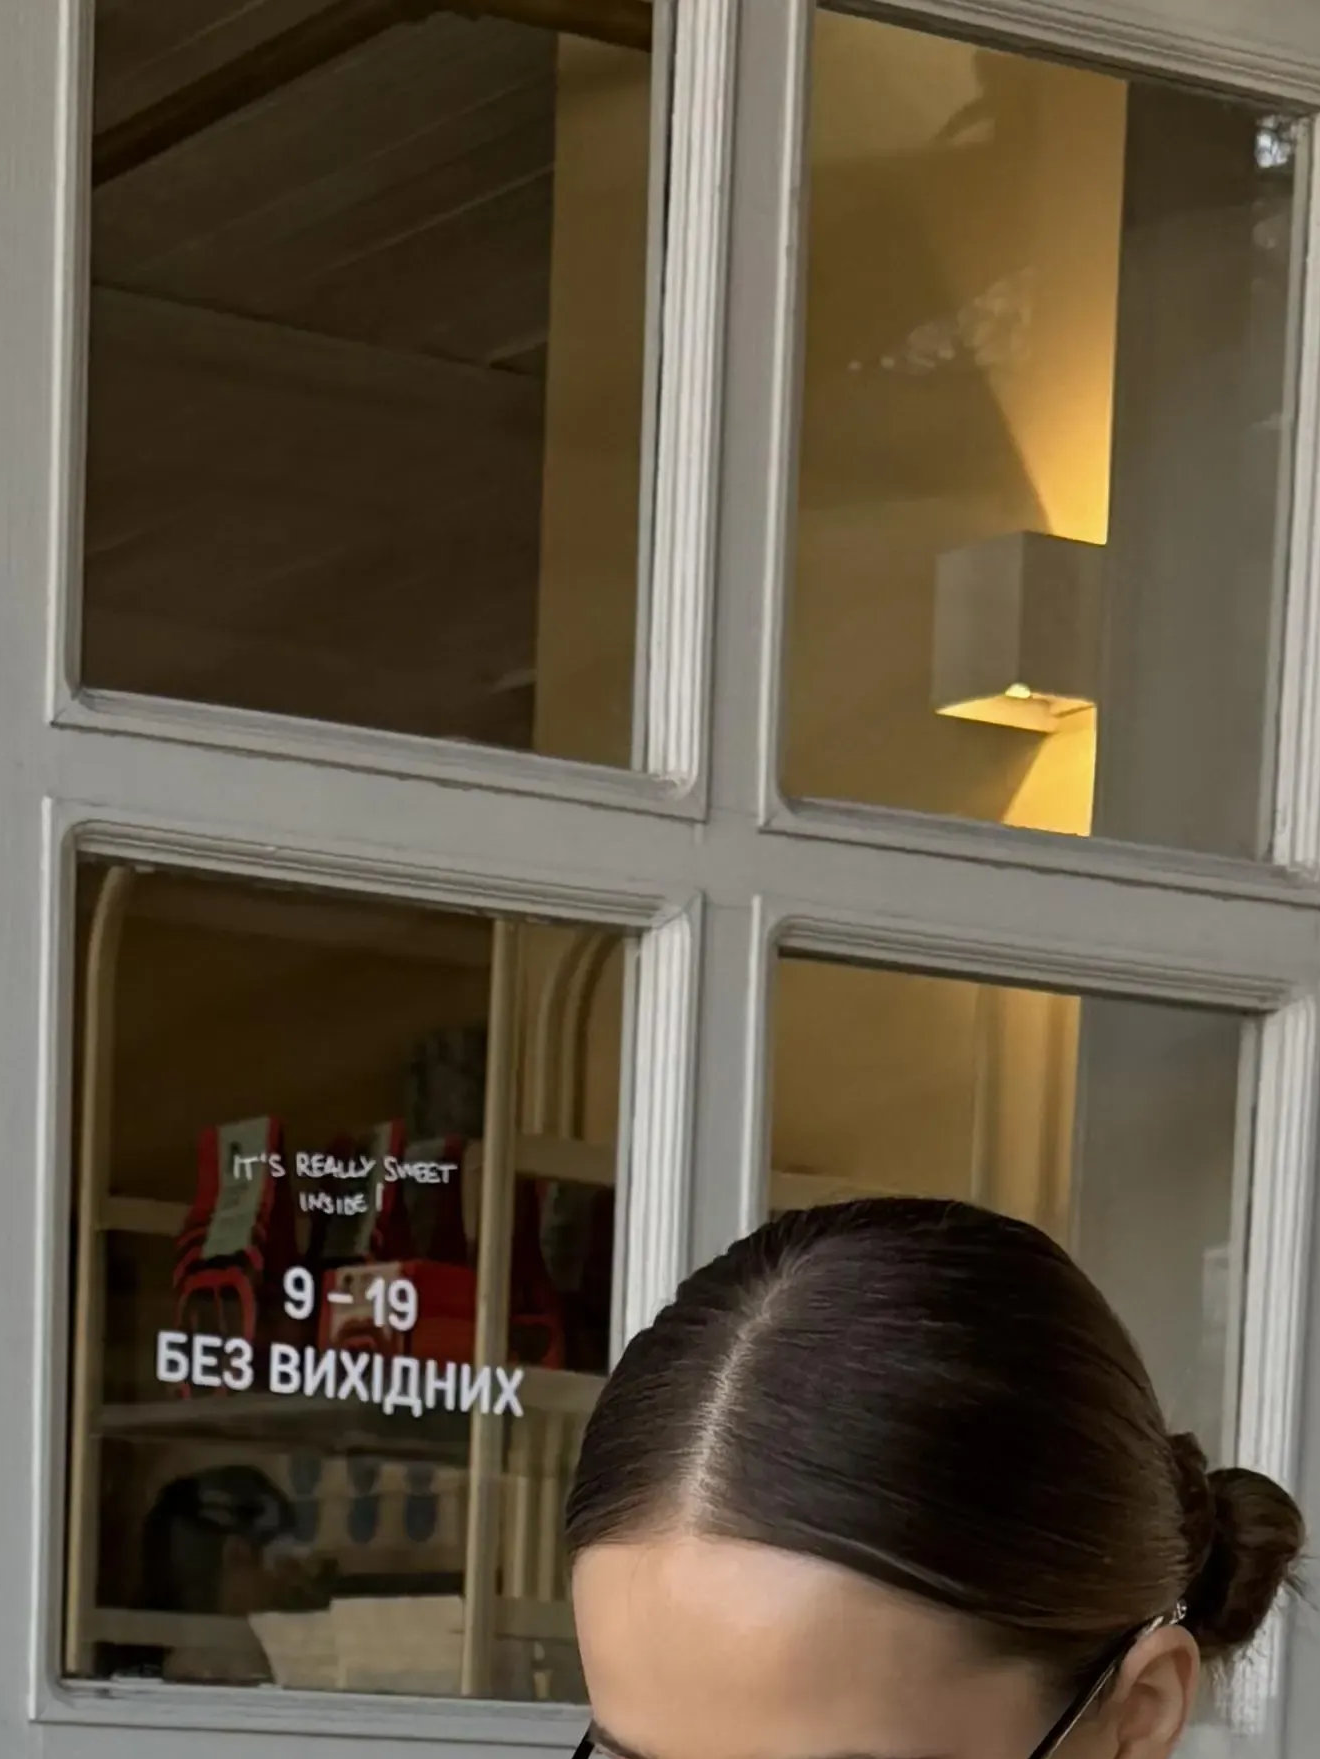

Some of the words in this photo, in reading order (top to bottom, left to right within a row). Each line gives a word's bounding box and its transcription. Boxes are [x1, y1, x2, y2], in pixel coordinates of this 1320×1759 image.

[232, 1152, 286, 1181] IT'S
[295, 1151, 376, 1178] REALLY
[383, 1155, 458, 1184] SWEET
[298, 1190, 369, 1216] INSIDE
[283, 1265, 315, 1320] 9
[365, 1277, 419, 1332] 19
[156, 1329, 254, 1391] БЕЗ
[269, 1342, 524, 1418] ВИХІДНИХ
